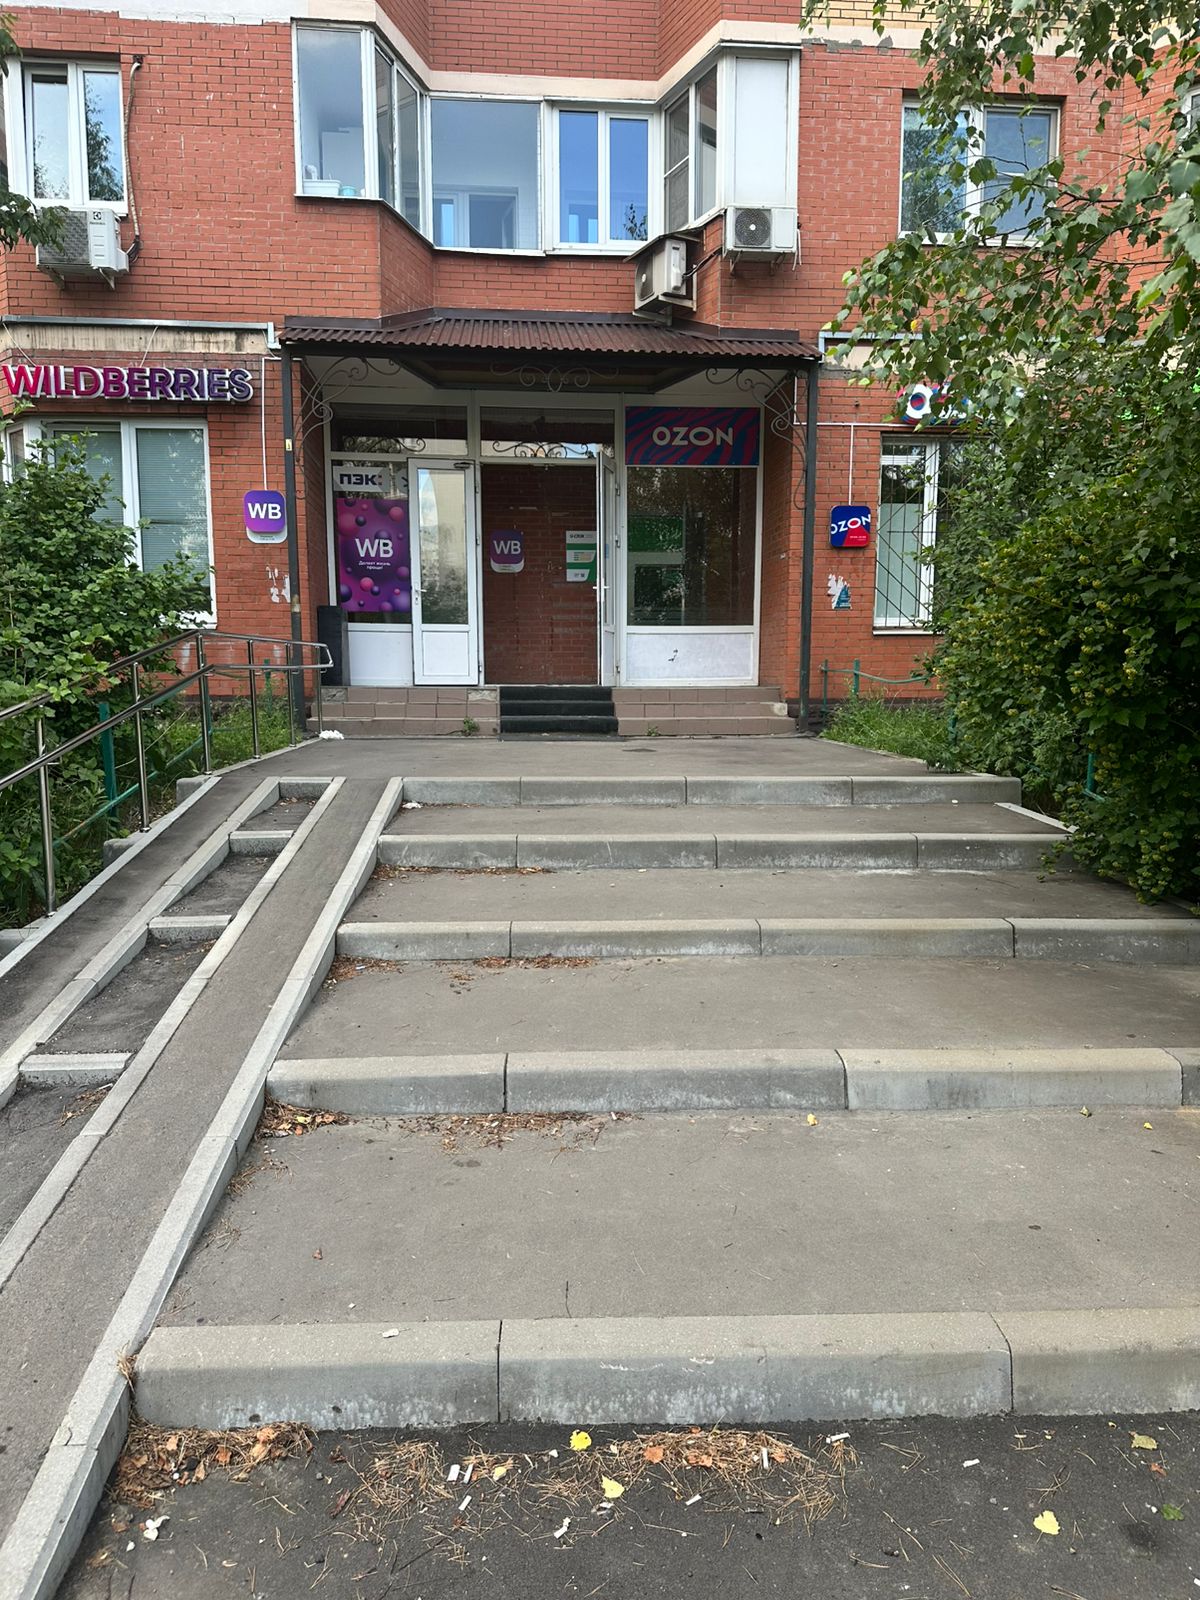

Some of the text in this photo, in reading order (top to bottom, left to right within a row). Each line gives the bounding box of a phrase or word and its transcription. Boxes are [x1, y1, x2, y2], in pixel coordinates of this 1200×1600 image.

[1, 363, 254, 402] WILDBERRIES
[652, 426, 734, 446] OZON
[247, 502, 282, 520] WB
[830, 514, 872, 535] OZON
[355, 538, 394, 558] WB
[493, 540, 521, 555] WB
